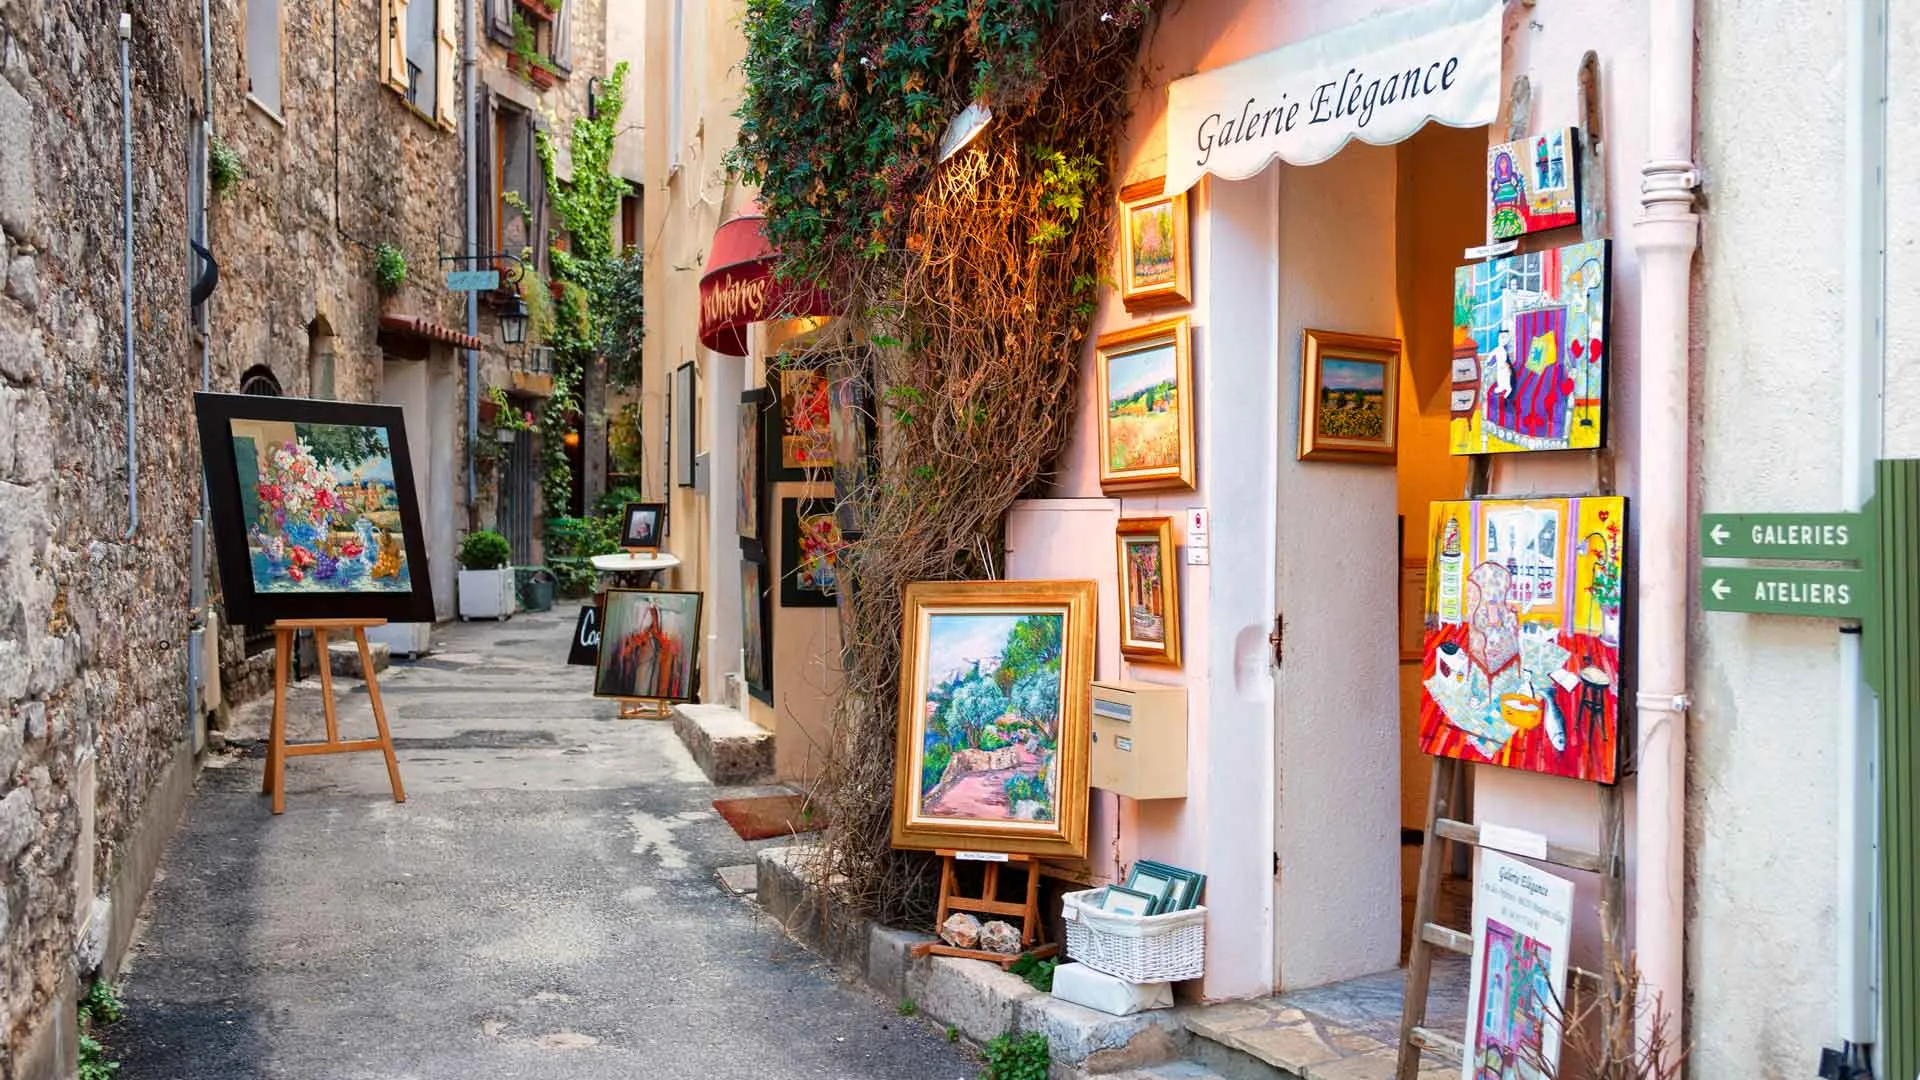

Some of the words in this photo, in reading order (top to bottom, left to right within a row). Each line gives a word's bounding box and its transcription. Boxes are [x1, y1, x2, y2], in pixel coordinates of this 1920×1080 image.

[1196, 93, 1300, 166] Galerie
[1308, 56, 1459, 128] Elégance
[1751, 525, 1849, 545] GALERIES
[1754, 581, 1850, 605] ATELIERS
